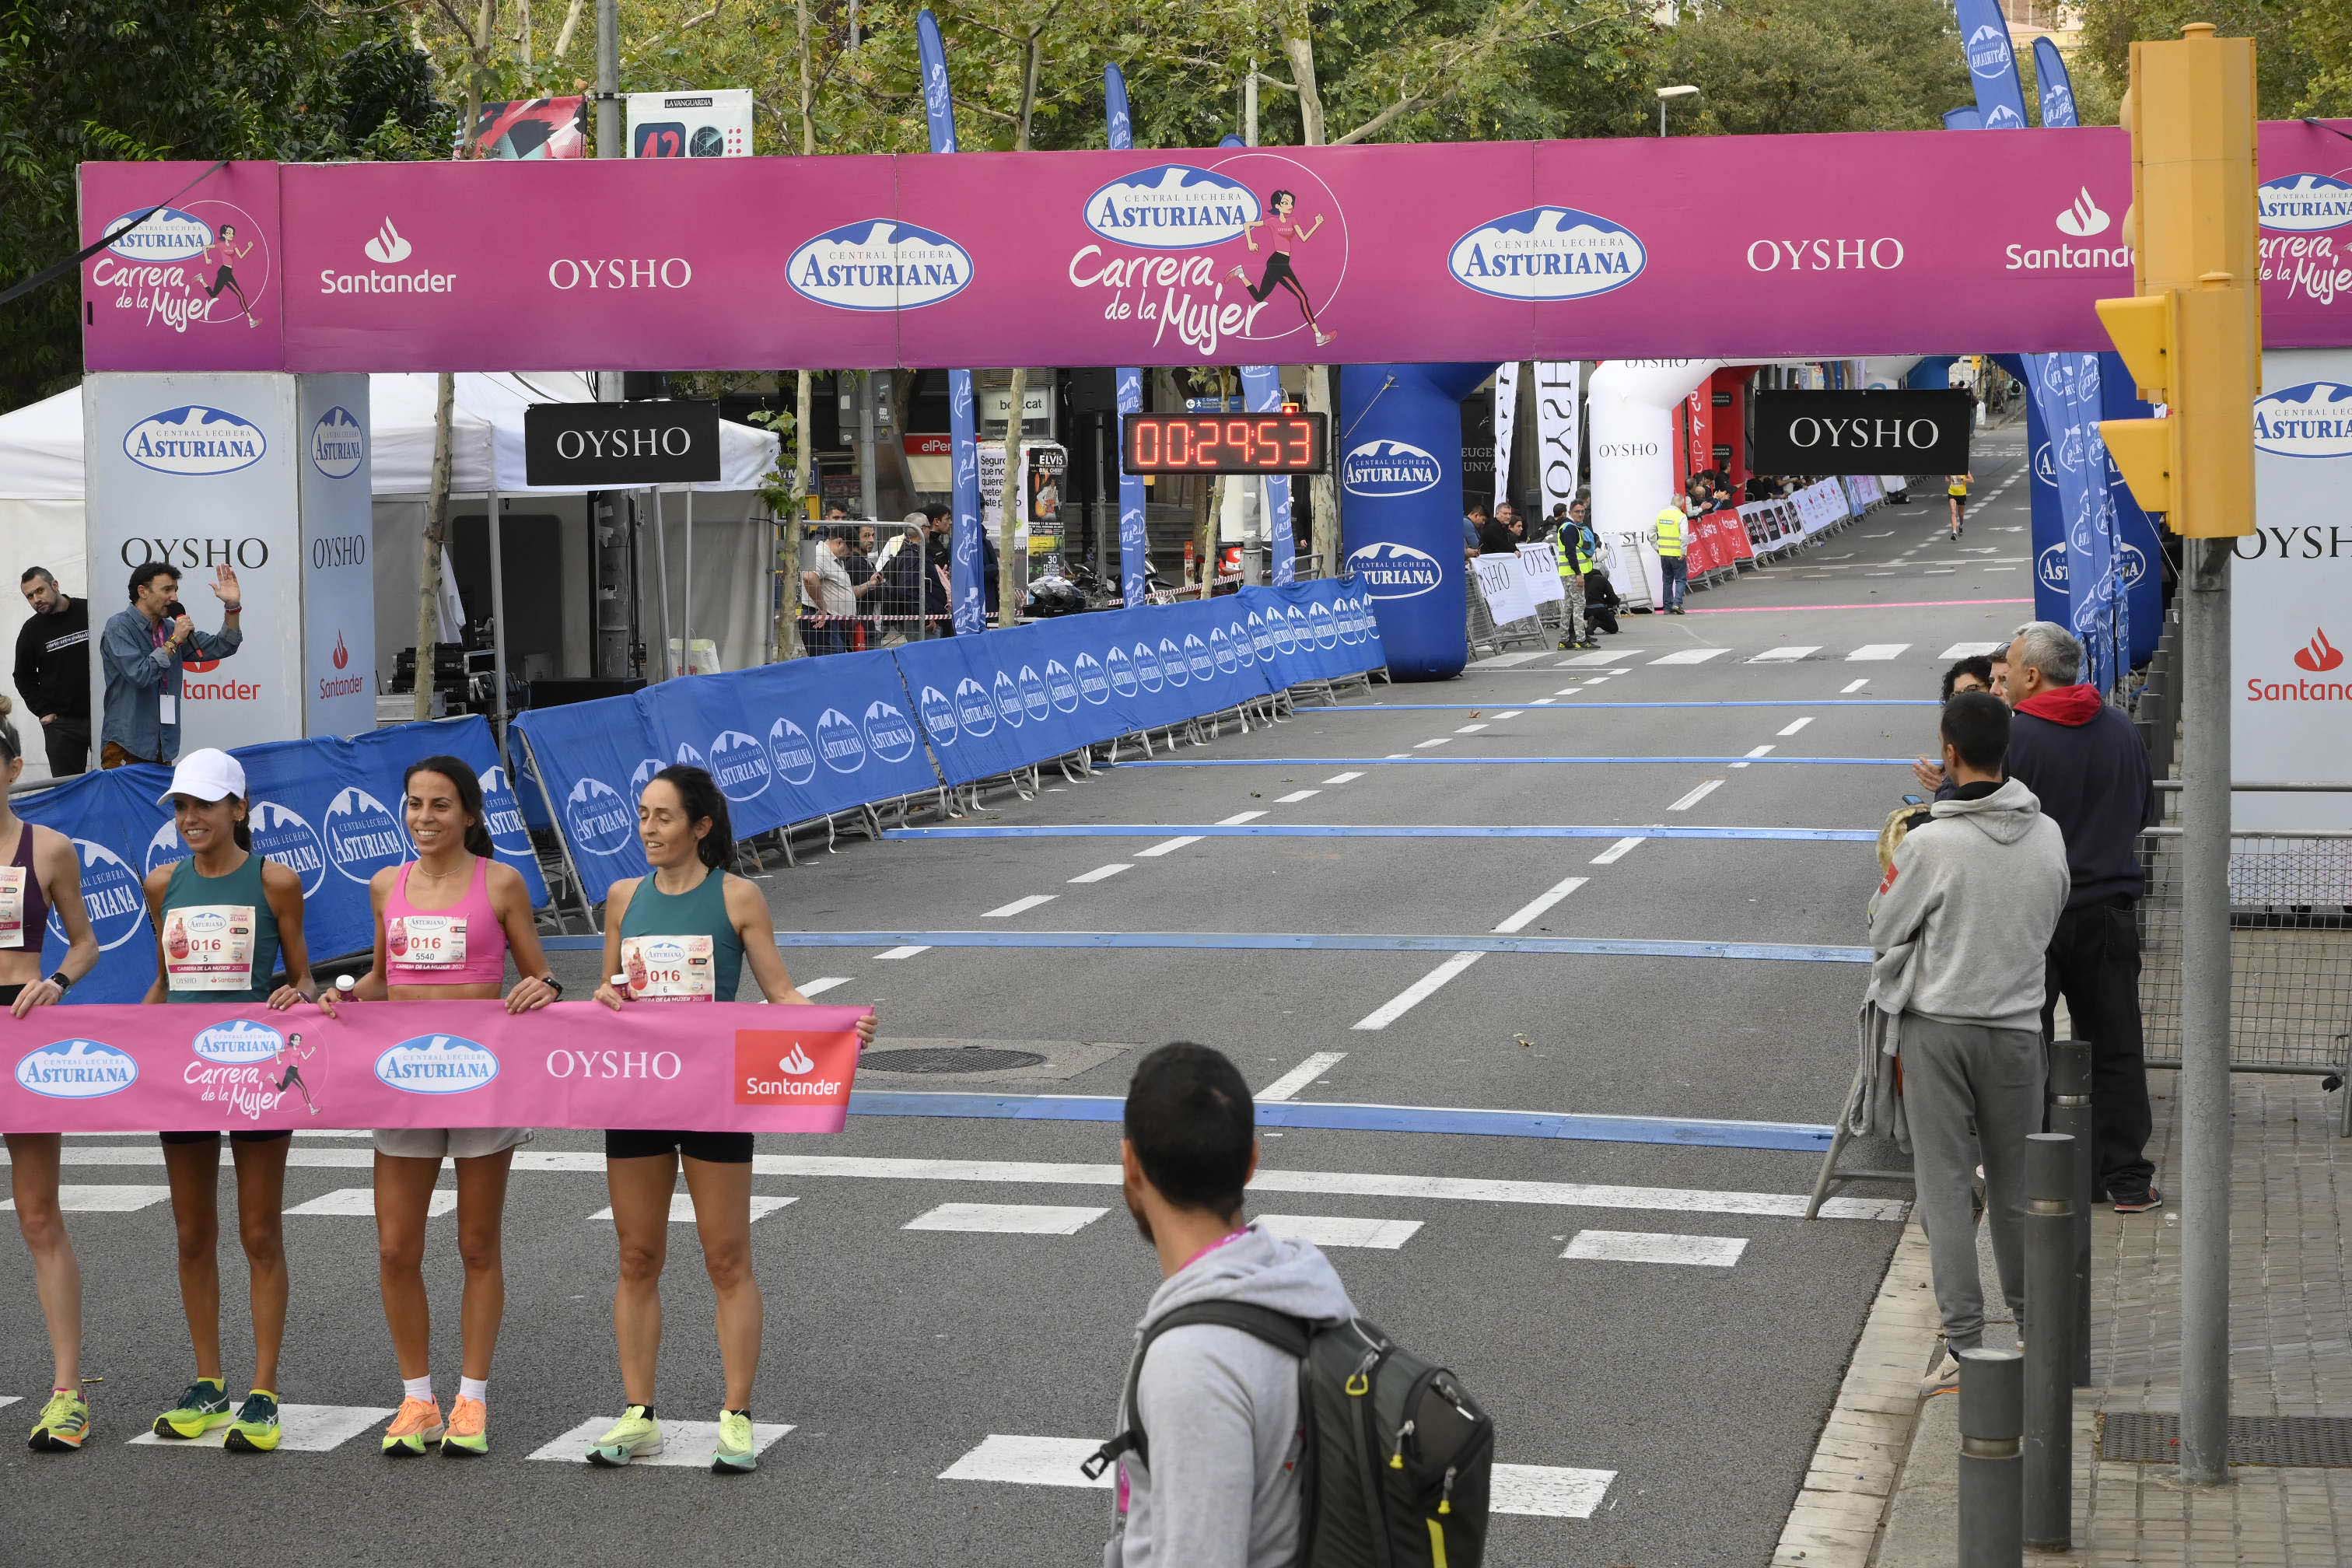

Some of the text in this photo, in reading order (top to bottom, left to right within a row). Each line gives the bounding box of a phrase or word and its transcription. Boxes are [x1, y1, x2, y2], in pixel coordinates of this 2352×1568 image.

[1125, 192, 1242, 203] CENTRAL LECHERA
[1097, 197, 1246, 228] ASTURIANA
[829, 250, 953, 260] CENTRAL LECHERA
[1494, 237, 1625, 250] CENTRAL LECHERA
[1747, 237, 1905, 272] OYSHO
[2259, 236, 2333, 259] arrera
[1069, 245, 1215, 289] Carrera
[1464, 243, 1632, 278] ASTURIANA
[2005, 243, 2135, 270] Santand
[93, 257, 184, 288] Carrera
[548, 257, 692, 289] OYSHO
[800, 254, 959, 287] ASTURIANA
[2277, 259, 2291, 280] la
[320, 268, 457, 295] Santander
[116, 285, 220, 333] de la Mujer
[1104, 283, 1269, 355] de la Mujer
[1000, 398, 1042, 411] b.cat
[2275, 408, 2327, 417] CENTRAL
[135, 430, 256, 458] ASTURIANA
[156, 429, 251, 438] CENTRAL LECHERA
[556, 427, 691, 460] OYSHO
[1137, 422, 1311, 465] 00:29:53
[1789, 417, 1939, 449] OYSHO
[316, 433, 361, 460] ASTURIANA
[1461, 447, 1495, 457] EUGE
[1599, 443, 1657, 458] OYSHO
[1039, 454, 1063, 465] ELVIS
[981, 468, 994, 477] que
[982, 479, 1006, 488] quiere
[1346, 463, 1434, 484] ASTURIANA
[121, 537, 268, 569] OYSHO
[313, 534, 366, 569] OYSHO
[1048, 555, 1057, 564] 30
[1356, 569, 1434, 585] TURIANA
[320, 674, 364, 700] Santander
[821, 734, 863, 760] ASTURIANA
[714, 757, 769, 787] ASTURIANA
[331, 826, 403, 863] ASTURIANA
[93, 869, 126, 887] LECHERA
[191, 939, 222, 951] 016
[411, 937, 441, 949] 016
[649, 970, 681, 982] 016
[200, 1036, 276, 1052] ASTURIANA
[24, 1061, 129, 1083] ASTURIANA
[184, 1061, 260, 1084] Carrera
[385, 1056, 489, 1079] ASTURIANA
[546, 1048, 682, 1080] OYSHO
[747, 1076, 841, 1096] Santander
[201, 1080, 287, 1120] de la Mujer
